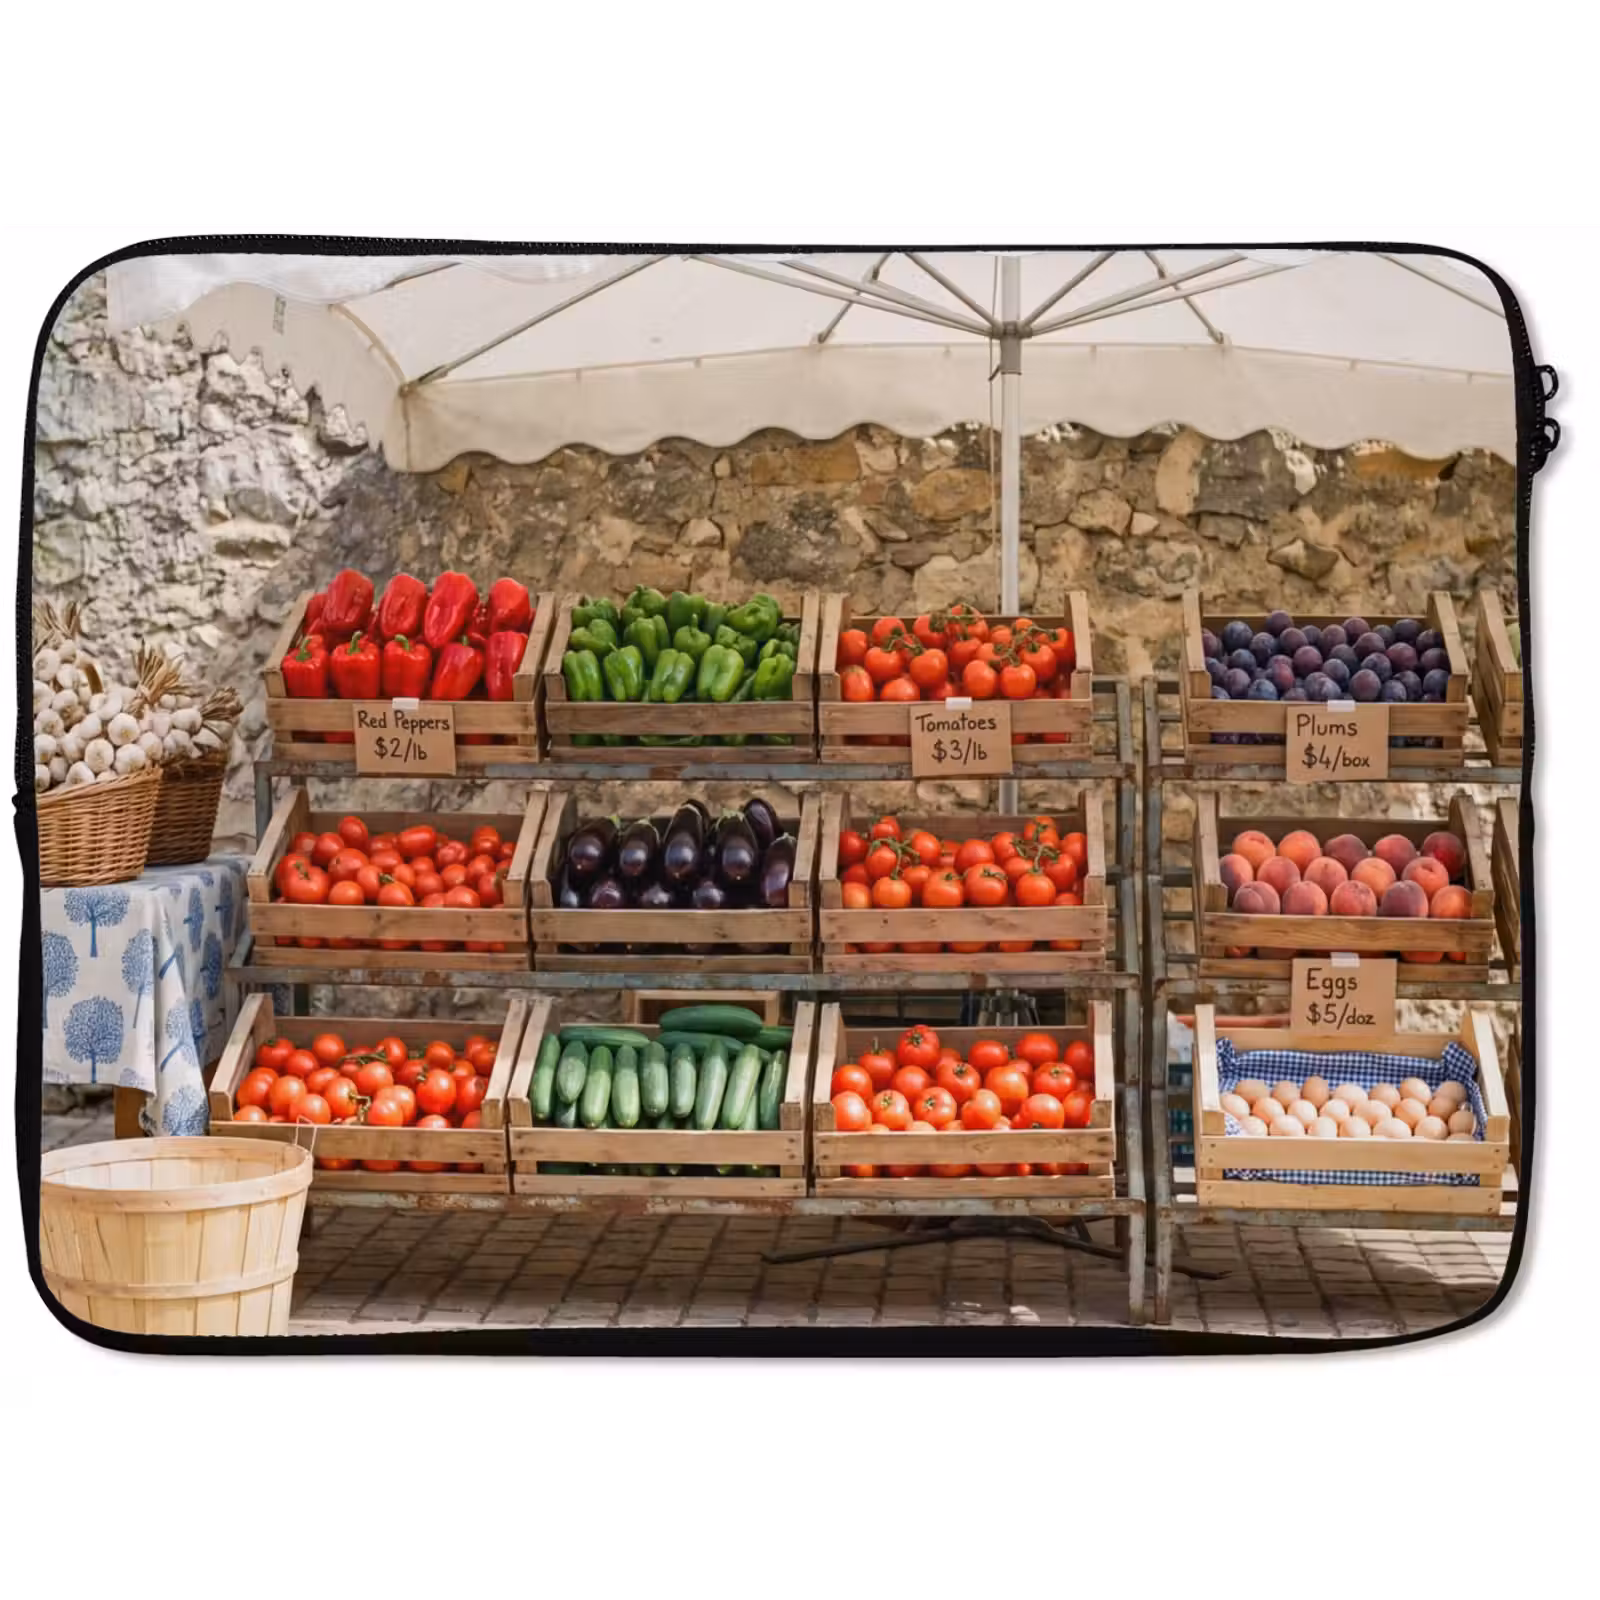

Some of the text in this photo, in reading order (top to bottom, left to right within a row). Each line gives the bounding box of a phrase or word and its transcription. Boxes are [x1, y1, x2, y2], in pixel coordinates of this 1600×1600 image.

[358, 709, 450, 735] Red Peppers
[915, 712, 997, 732] Tomatoes
[1296, 713, 1358, 737] Plums
[374, 736, 428, 763] $2/lb
[931, 738, 987, 765] $3/lb
[1301, 742, 1370, 772] $4/box
[1306, 967, 1358, 999] Eggs
[1306, 1002, 1376, 1031] $5/doz
